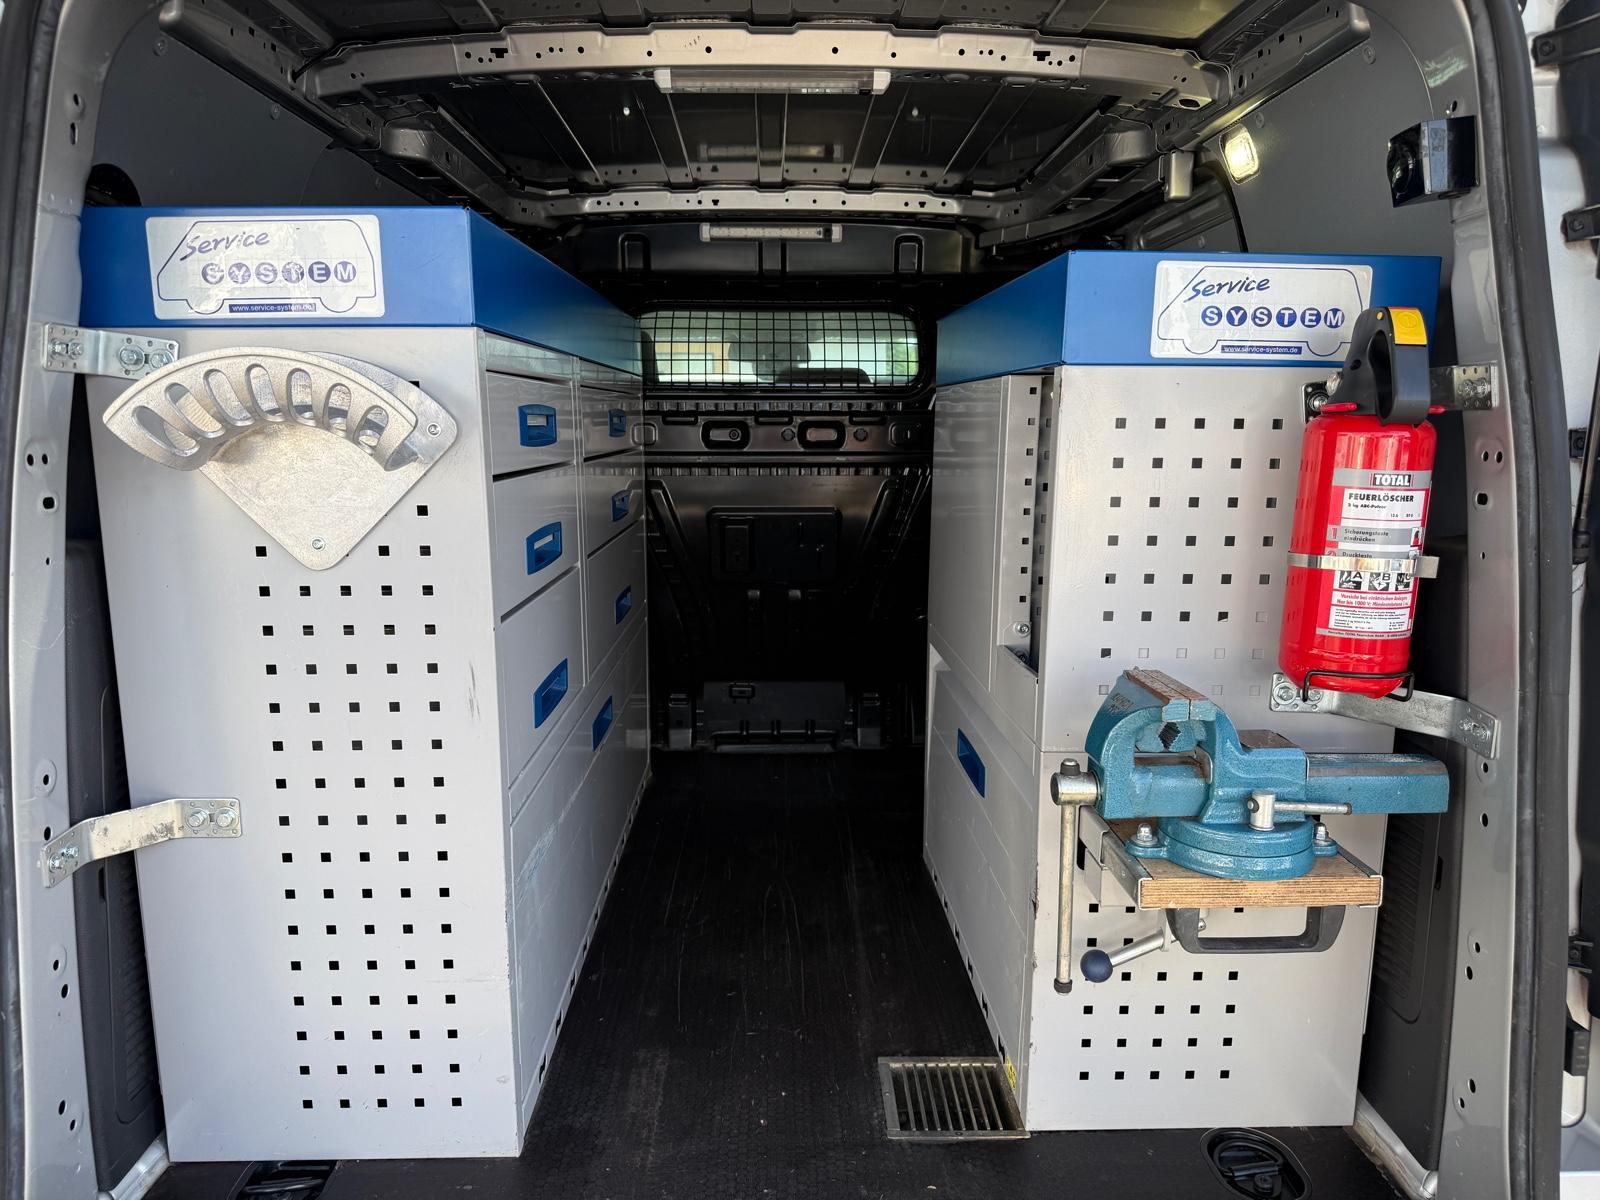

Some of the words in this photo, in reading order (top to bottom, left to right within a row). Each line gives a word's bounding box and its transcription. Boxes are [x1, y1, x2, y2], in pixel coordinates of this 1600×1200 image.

[180, 231, 270, 261] Service
[202, 262, 356, 285] SYSTEM
[1183, 276, 1271, 303] Service
[1202, 306, 1345, 328] SYSTEM
[1223, 345, 1298, 355] www.service-system.de
[1374, 474, 1409, 486] TOTAL
[1348, 492, 1414, 503] FEUERLÖSCHER
[1344, 528, 1389, 536] Sicherungstaste
[1353, 571, 1363, 580] A
